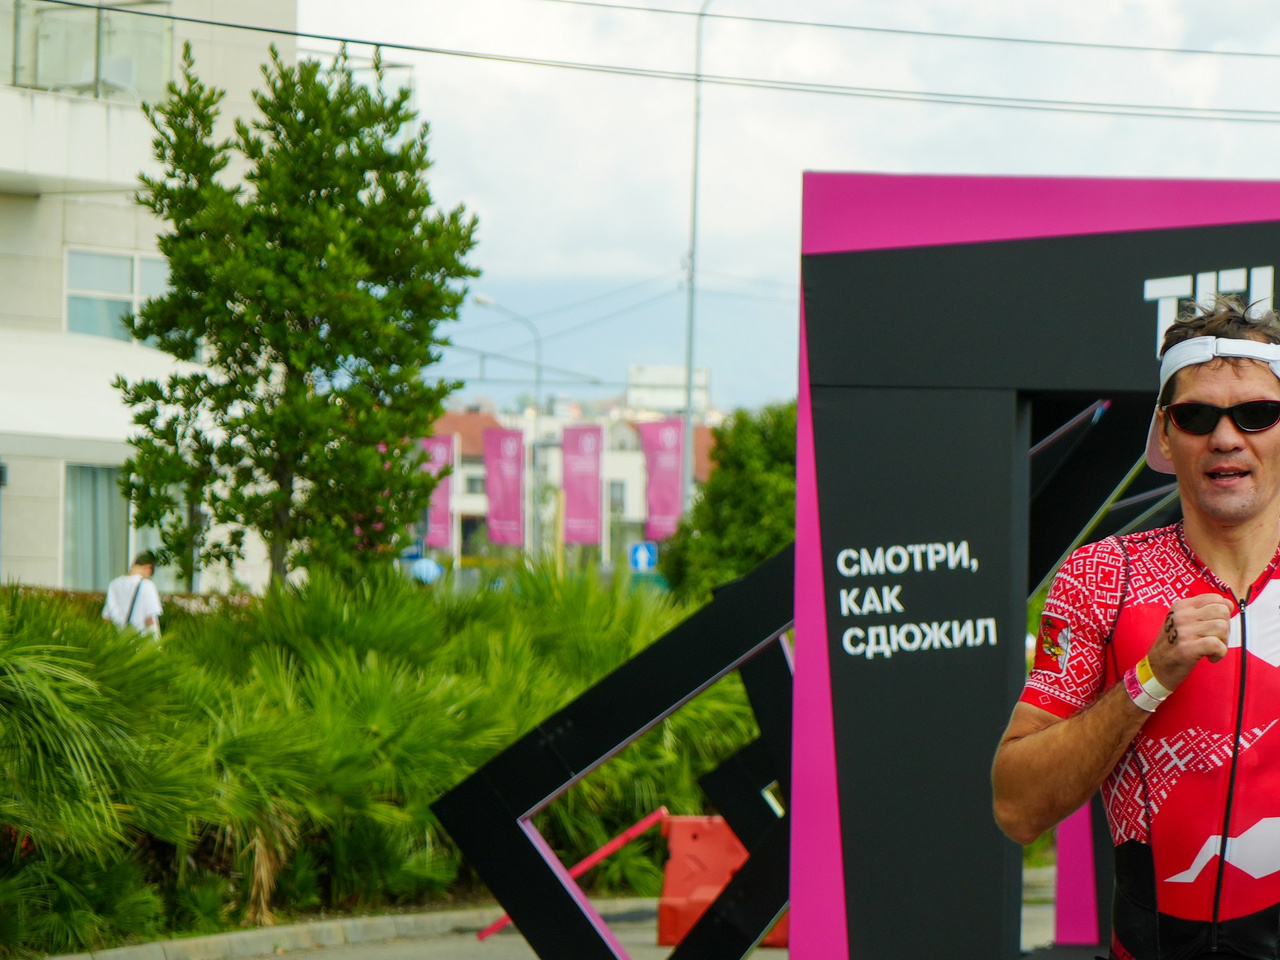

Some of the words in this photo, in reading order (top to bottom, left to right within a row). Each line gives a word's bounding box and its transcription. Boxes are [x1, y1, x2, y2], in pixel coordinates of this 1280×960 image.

[836, 540, 978, 578] СМОТРИ,
[839, 584, 905, 617] КАК
[842, 617, 998, 659] СДЮЖИЛ
